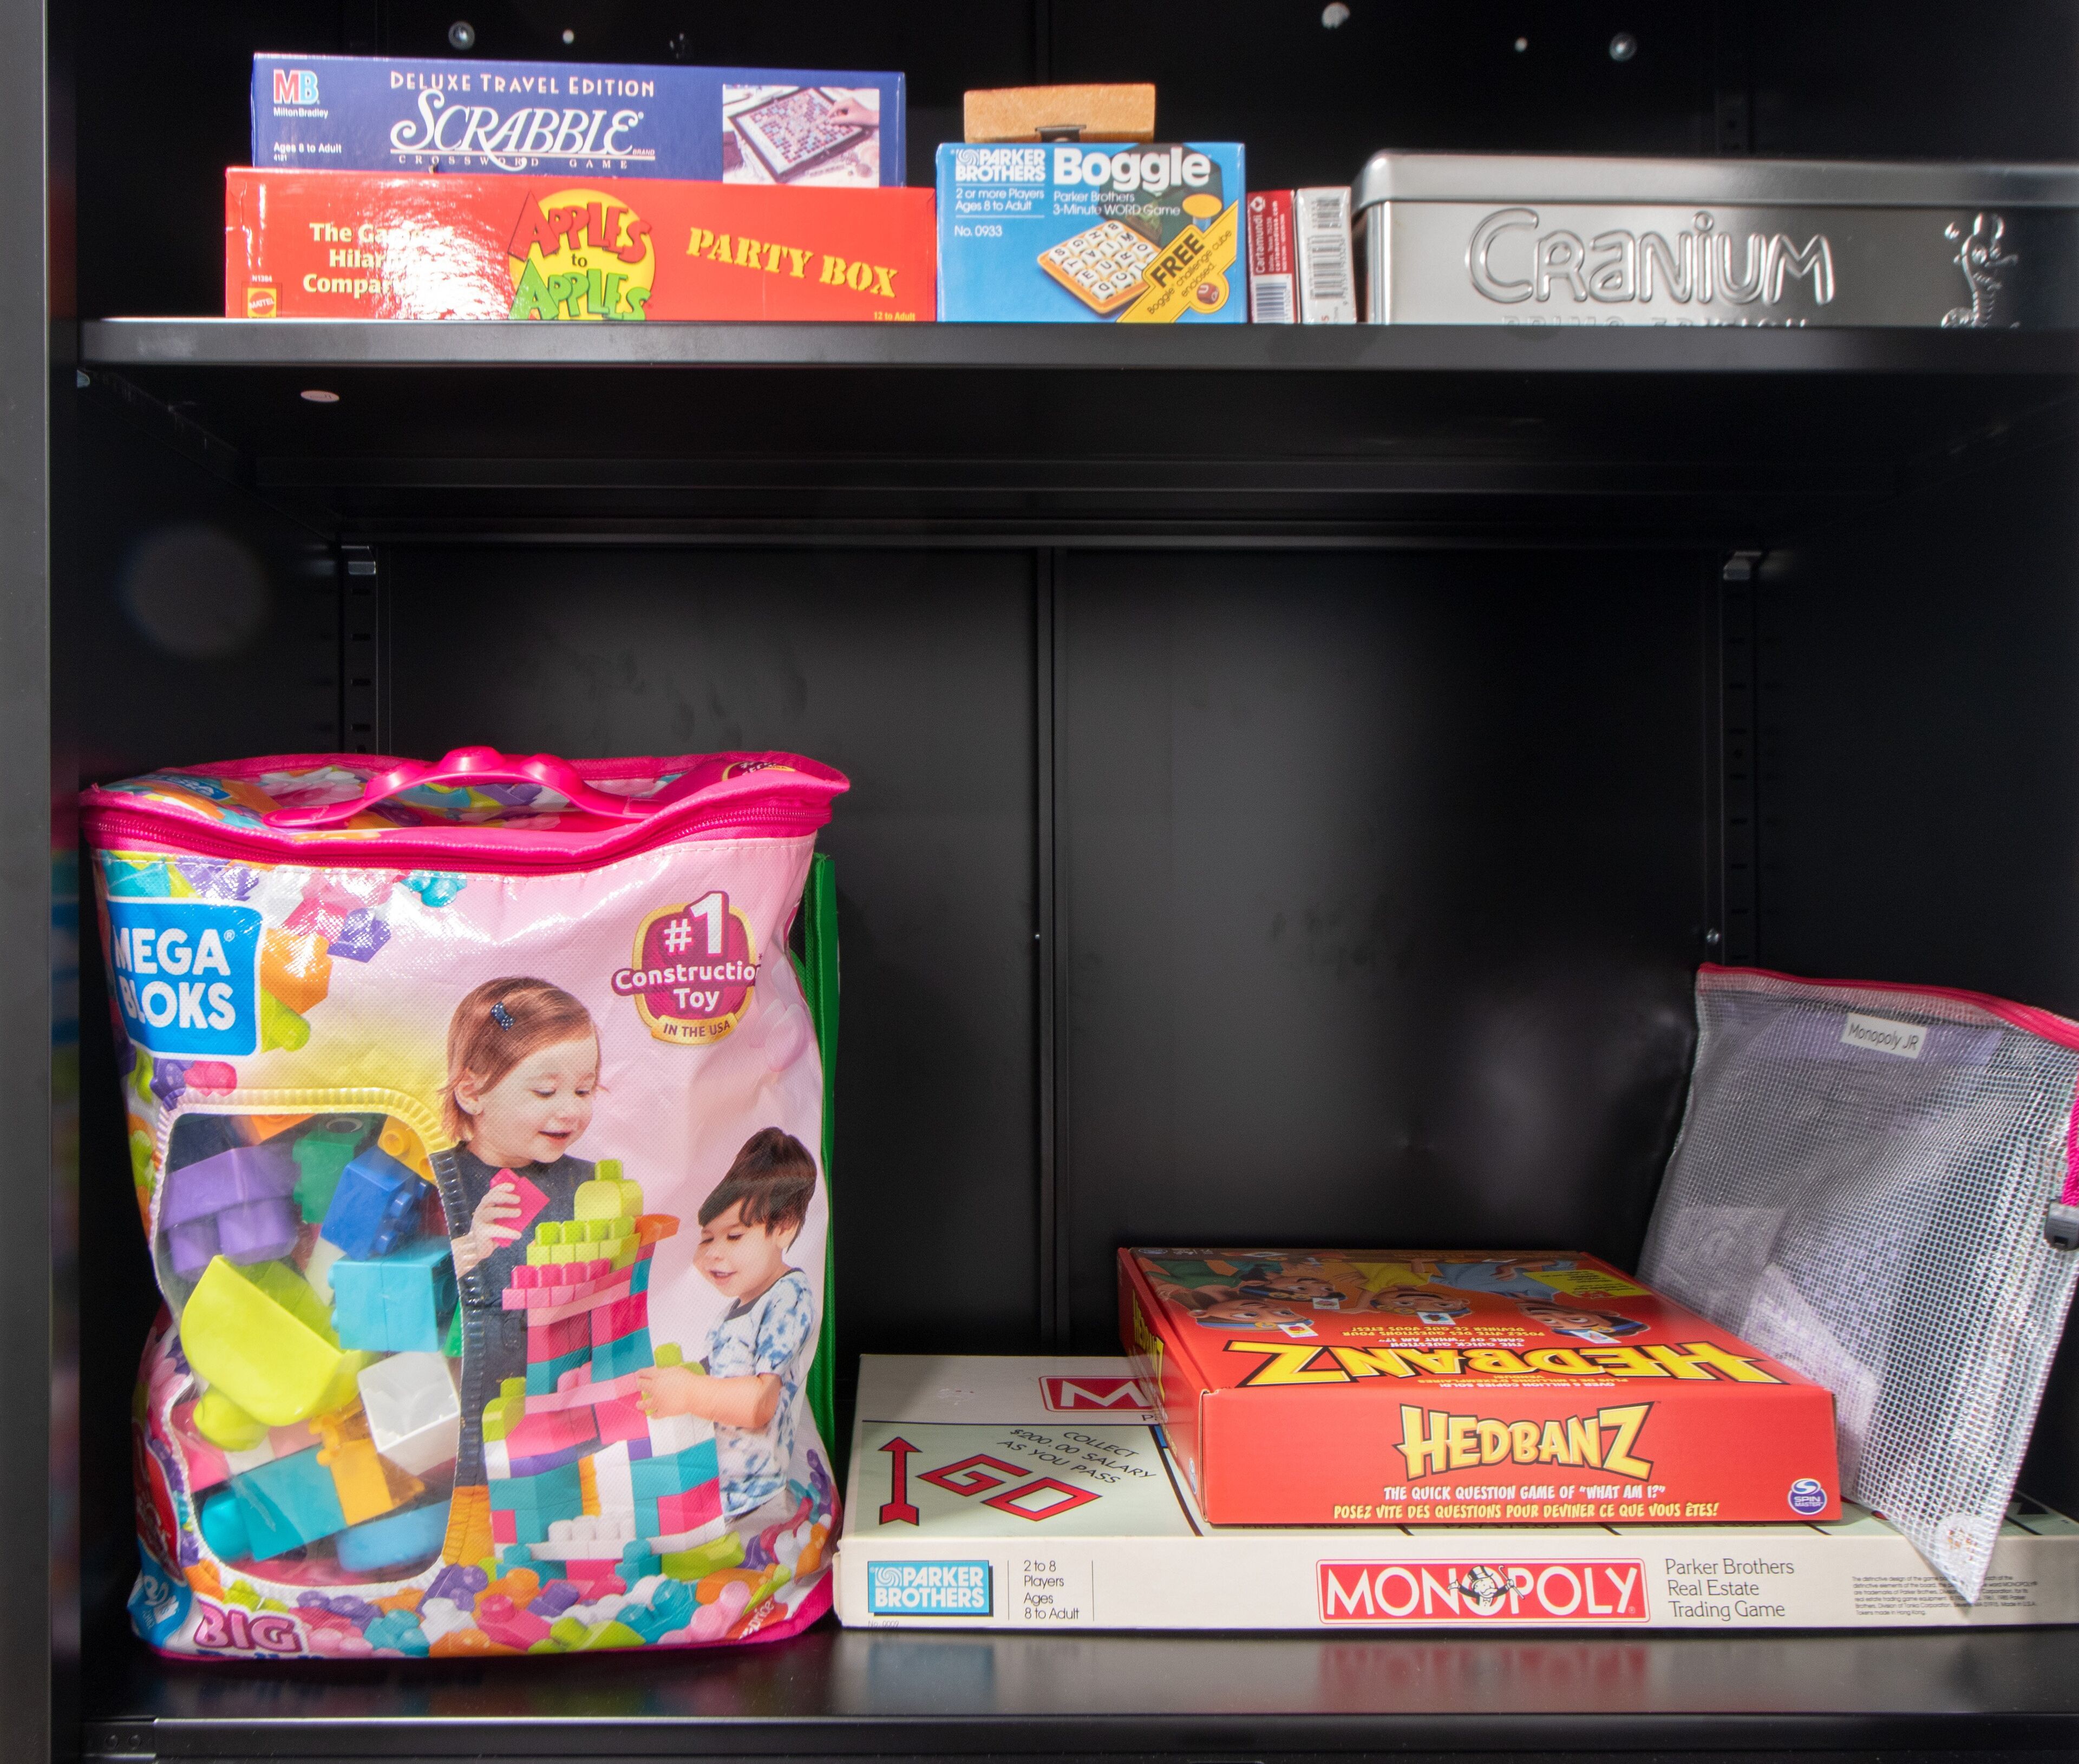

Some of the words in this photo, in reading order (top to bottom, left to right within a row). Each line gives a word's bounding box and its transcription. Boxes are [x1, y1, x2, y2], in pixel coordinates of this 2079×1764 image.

[273, 69, 319, 105] MB
[390, 71, 470, 91] DELUXE
[480, 74, 559, 94] TRAVEL
[569, 76, 654, 97] EDITION
[390, 89, 640, 172] SCRABBLE
[273, 142, 296, 154] Ages
[307, 143, 316, 153] to
[318, 143, 342, 153] Adult
[979, 148, 1046, 165] PARKER
[398, 155, 539, 167] CROSSWORD
[569, 159, 628, 169] GAME
[1054, 146, 1211, 193] Boggle
[955, 165, 1046, 182] BROTHERS
[956, 188, 963, 199] 2
[965, 190, 978, 199] or
[978, 190, 1006, 199] more
[1009, 188, 1044, 201] Players
[1054, 191, 1088, 202] Parker
[1090, 190, 1135, 202] Brothers
[955, 200, 982, 213] Ages
[984, 200, 990, 211] 8
[992, 201, 1003, 211] to
[1005, 200, 1032, 211] Adult
[1053, 204, 1102, 215] 3-Minute
[1104, 204, 1141, 215] WORD
[1143, 204, 1181, 215] Game
[309, 222, 353, 242] The
[507, 189, 652, 264] APPLES
[954, 225, 972, 237] No.
[975, 225, 1003, 237] 0933
[1253, 214, 1265, 273] Cartamundi
[572, 253, 588, 267] to
[685, 227, 813, 278] PARTY
[819, 254, 898, 298] BOX
[1150, 233, 1206, 288] FREE
[1147, 287, 1175, 315] Boggle
[1176, 248, 1213, 288] challenge
[1212, 229, 1232, 251] cube
[508, 258, 651, 320] APPLES
[250, 297, 274, 310] MATTEL
[873, 311, 883, 320] 12
[885, 312, 893, 320] to
[894, 311, 916, 321] Adult
[664, 893, 723, 954] #1
[112, 927, 231, 976] MEGA
[117, 980, 236, 1031] BLOKS
[673, 987, 720, 1012] Toy
[663, 1023, 678, 1036] IN
[682, 1026, 706, 1038] THE
[709, 1020, 730, 1035] USA
[1848, 1022, 1903, 1051] Monopoly
[1903, 1034, 1919, 1051] JR
[1223, 1341, 1790, 1388] HEDBANZ
[1063, 1431, 1140, 1458] COLLECT
[1393, 1402, 1654, 1482] HEDBANZ
[997, 1440, 1028, 1451] AS
[1027, 1448, 1070, 1466] YOU
[1070, 1464, 1121, 1484] PASS
[1010, 1428, 1080, 1454] $200.00
[1081, 1452, 1156, 1478] SALARY
[915, 1453, 1103, 1522] GO
[1384, 1486, 1407, 1500] THE
[1411, 1486, 1451, 1500] QUICK
[1455, 1485, 1516, 1500] QUESTION
[1520, 1485, 1555, 1499] GAME
[1559, 1485, 1574, 1499] OF
[1623, 1485, 1643, 1499] AM
[1333, 1505, 1372, 1519] POSEZ
[1376, 1504, 1403, 1519] VITE
[1407, 1504, 1430, 1519] DES
[1434, 1504, 1501, 1519] QUESTIONS
[1506, 1504, 1539, 1518] POUR
[1543, 1503, 1595, 1518] DEVINER
[1599, 1504, 1614, 1518] CE
[1619, 1503, 1644, 1517] QUE
[1648, 1503, 1681, 1517] VOUS
[1685, 1502, 1720, 1517] ÊTES!
[1023, 1559, 1031, 1572] 2
[1034, 1560, 1046, 1572] to
[1049, 1559, 1057, 1572] 8
[1665, 1558, 1718, 1575] Parker
[1724, 1559, 1794, 1575] Brothers
[902, 1567, 984, 1587] PARKER
[1023, 1575, 1064, 1588] Players
[1668, 1579, 1703, 1596] Real
[1708, 1579, 1760, 1596] Estate
[875, 1586, 985, 1608] BROTHERS
[1023, 1592, 1054, 1606] Ages
[1326, 1565, 1638, 1617] MONOPOLY
[1024, 1608, 1032, 1619] 8
[1034, 1608, 1046, 1619] to
[1048, 1607, 1080, 1619] Adult
[1672, 1601, 1731, 1622] Trading
[1735, 1601, 1786, 1617] Game
[194, 1599, 302, 1652] BIG
